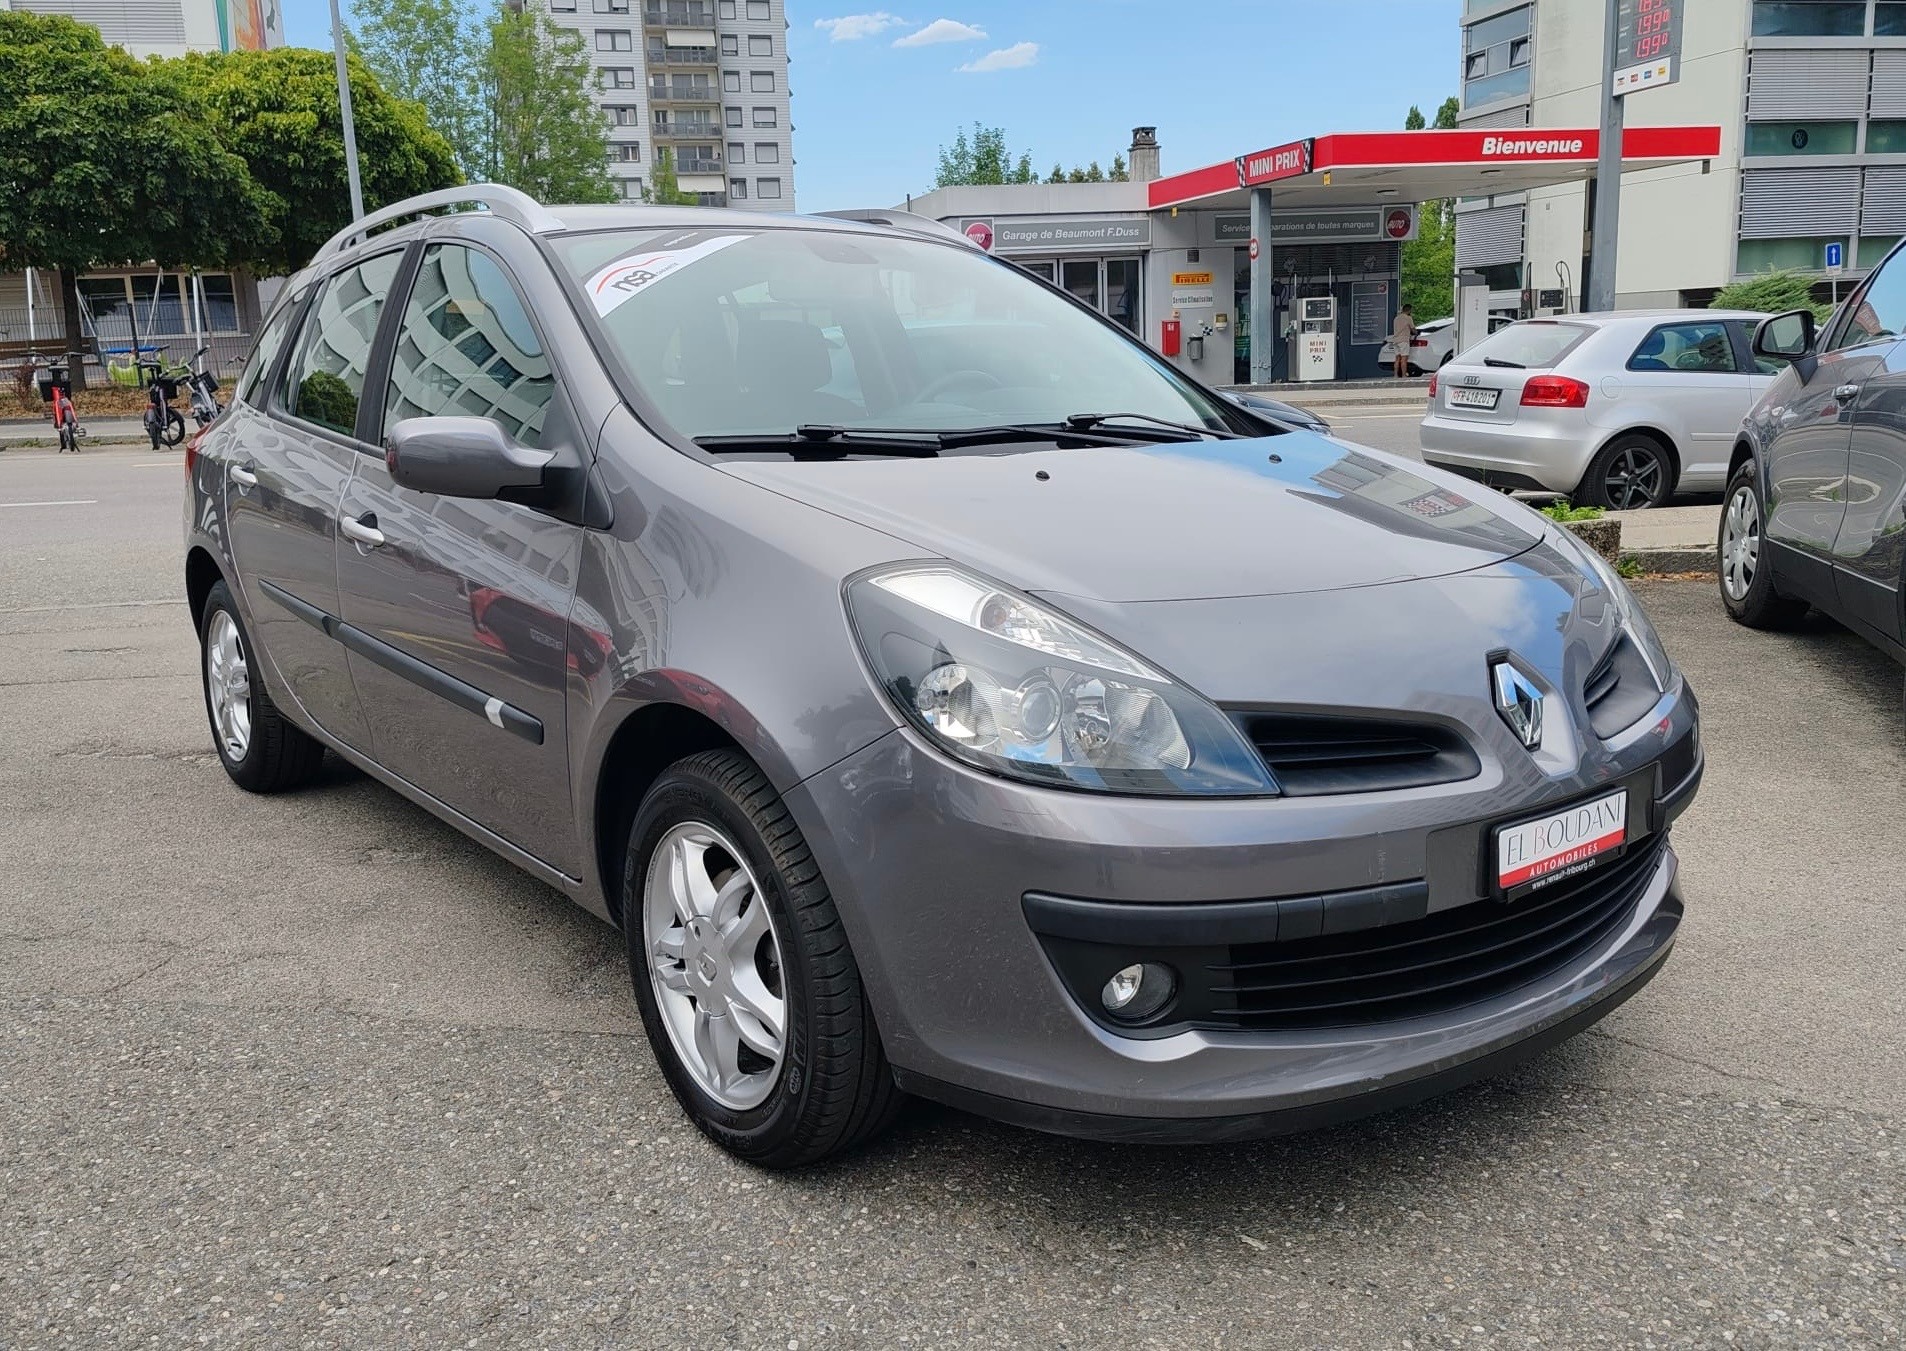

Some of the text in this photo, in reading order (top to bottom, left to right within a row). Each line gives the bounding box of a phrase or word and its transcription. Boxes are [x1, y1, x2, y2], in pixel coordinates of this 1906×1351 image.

[1481, 137, 1583, 155] Bienvenue
[1249, 149, 1300, 178] MINI PRIX
[1002, 230, 1038, 242] Garage
[1040, 229, 1053, 239] de
[1055, 227, 1105, 240] Beaumont
[1106, 226, 1140, 238] F.Duss
[1305, 221, 1316, 230] de
[1317, 221, 1341, 230] toutes
[1342, 221, 1375, 232] marques
[611, 269, 659, 292] nsa
[1507, 795, 1621, 866] EL BOUDANI
[1529, 842, 1598, 877] AUTOMOBILES
[1531, 858, 1596, 891] www.renault-fribourg.ch
